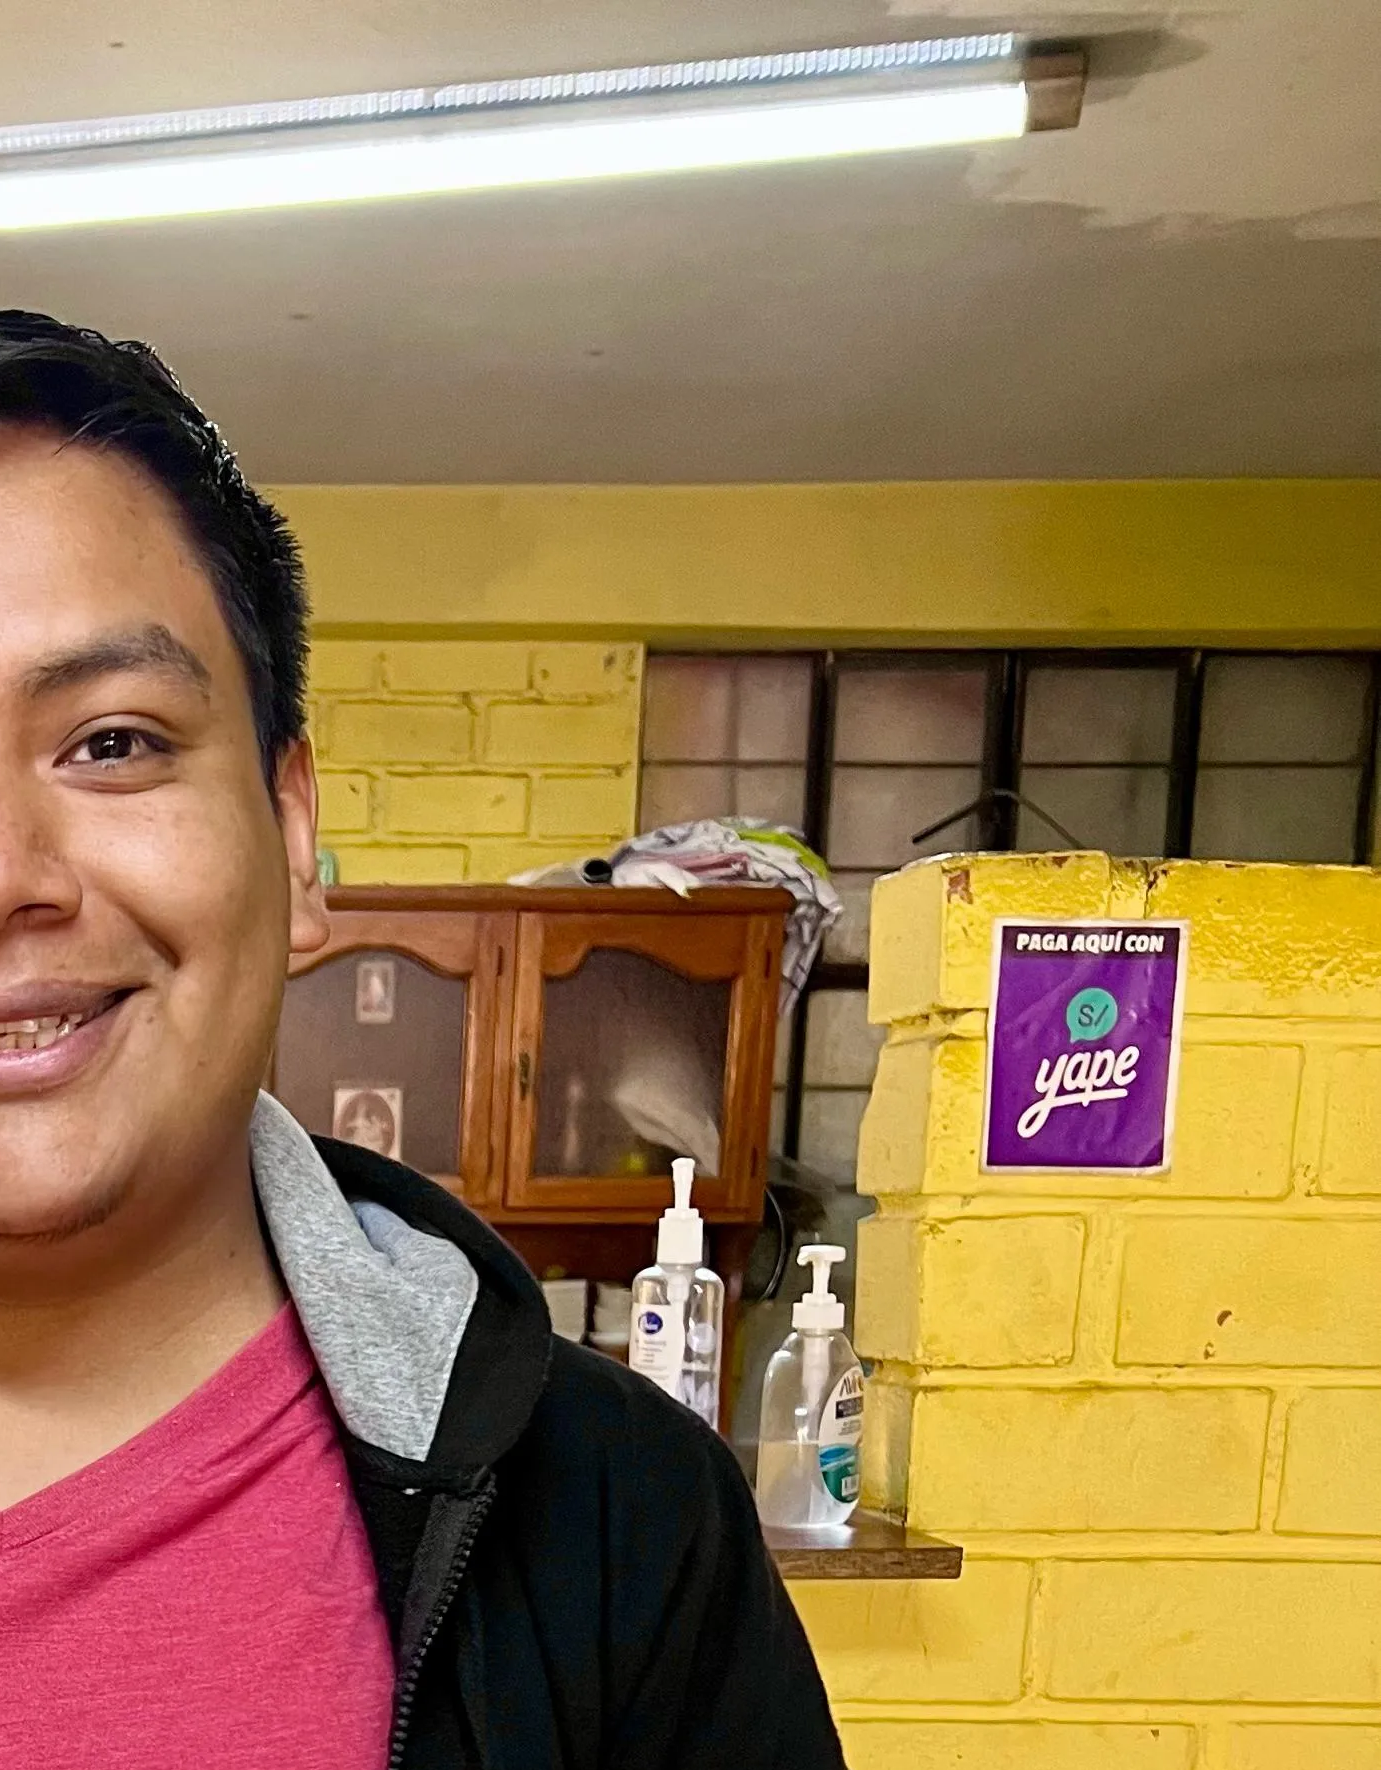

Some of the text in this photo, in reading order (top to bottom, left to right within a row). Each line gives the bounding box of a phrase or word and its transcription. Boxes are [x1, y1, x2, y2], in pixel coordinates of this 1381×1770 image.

[1016, 930, 1164, 954] PAGA AQUÍ CON
[1078, 1003, 1109, 1027] S/
[1017, 1046, 1139, 1138] yape
